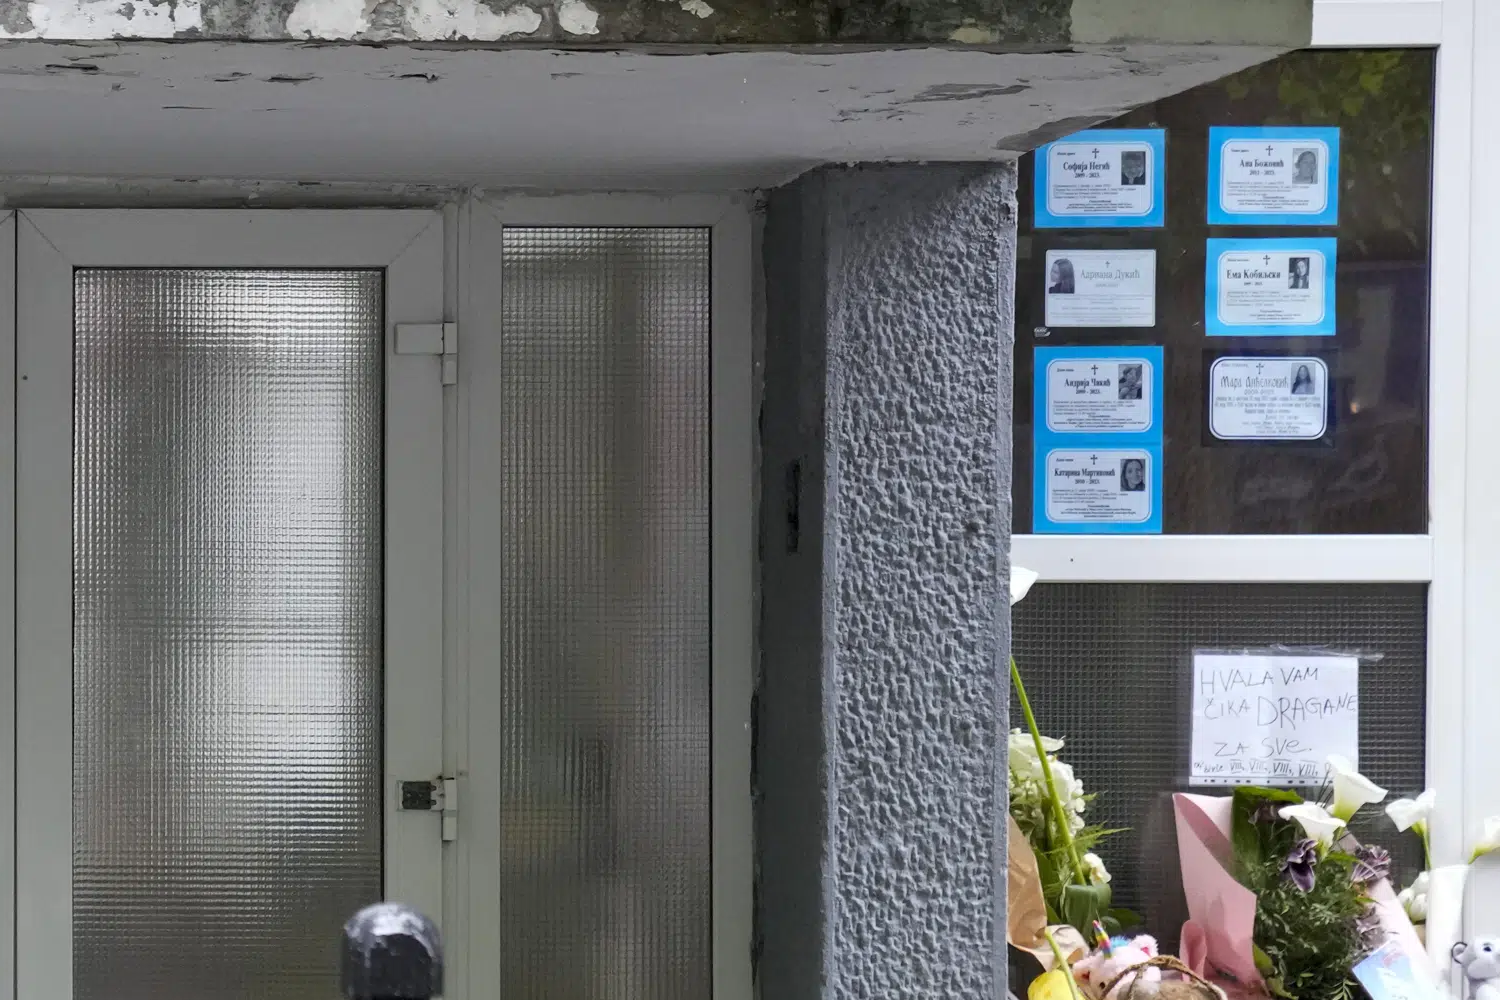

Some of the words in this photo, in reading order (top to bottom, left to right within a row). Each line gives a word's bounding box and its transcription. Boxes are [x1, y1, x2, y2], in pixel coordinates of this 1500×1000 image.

[1063, 161, 1088, 172] Софија
[1239, 159, 1253, 167] Ана
[1114, 269, 1140, 280] Дукић
[1226, 269, 1242, 279] Ема
[1243, 269, 1280, 279] Кобиљски
[1064, 378, 1089, 388] Андрија
[1220, 376, 1242, 391] Мара
[1054, 468, 1081, 478] Катарина
[1201, 668, 1274, 694] HVALA
[1280, 667, 1319, 685] VAM
[1204, 698, 1250, 720] ČIKA
[1214, 742, 1250, 757] ZA
